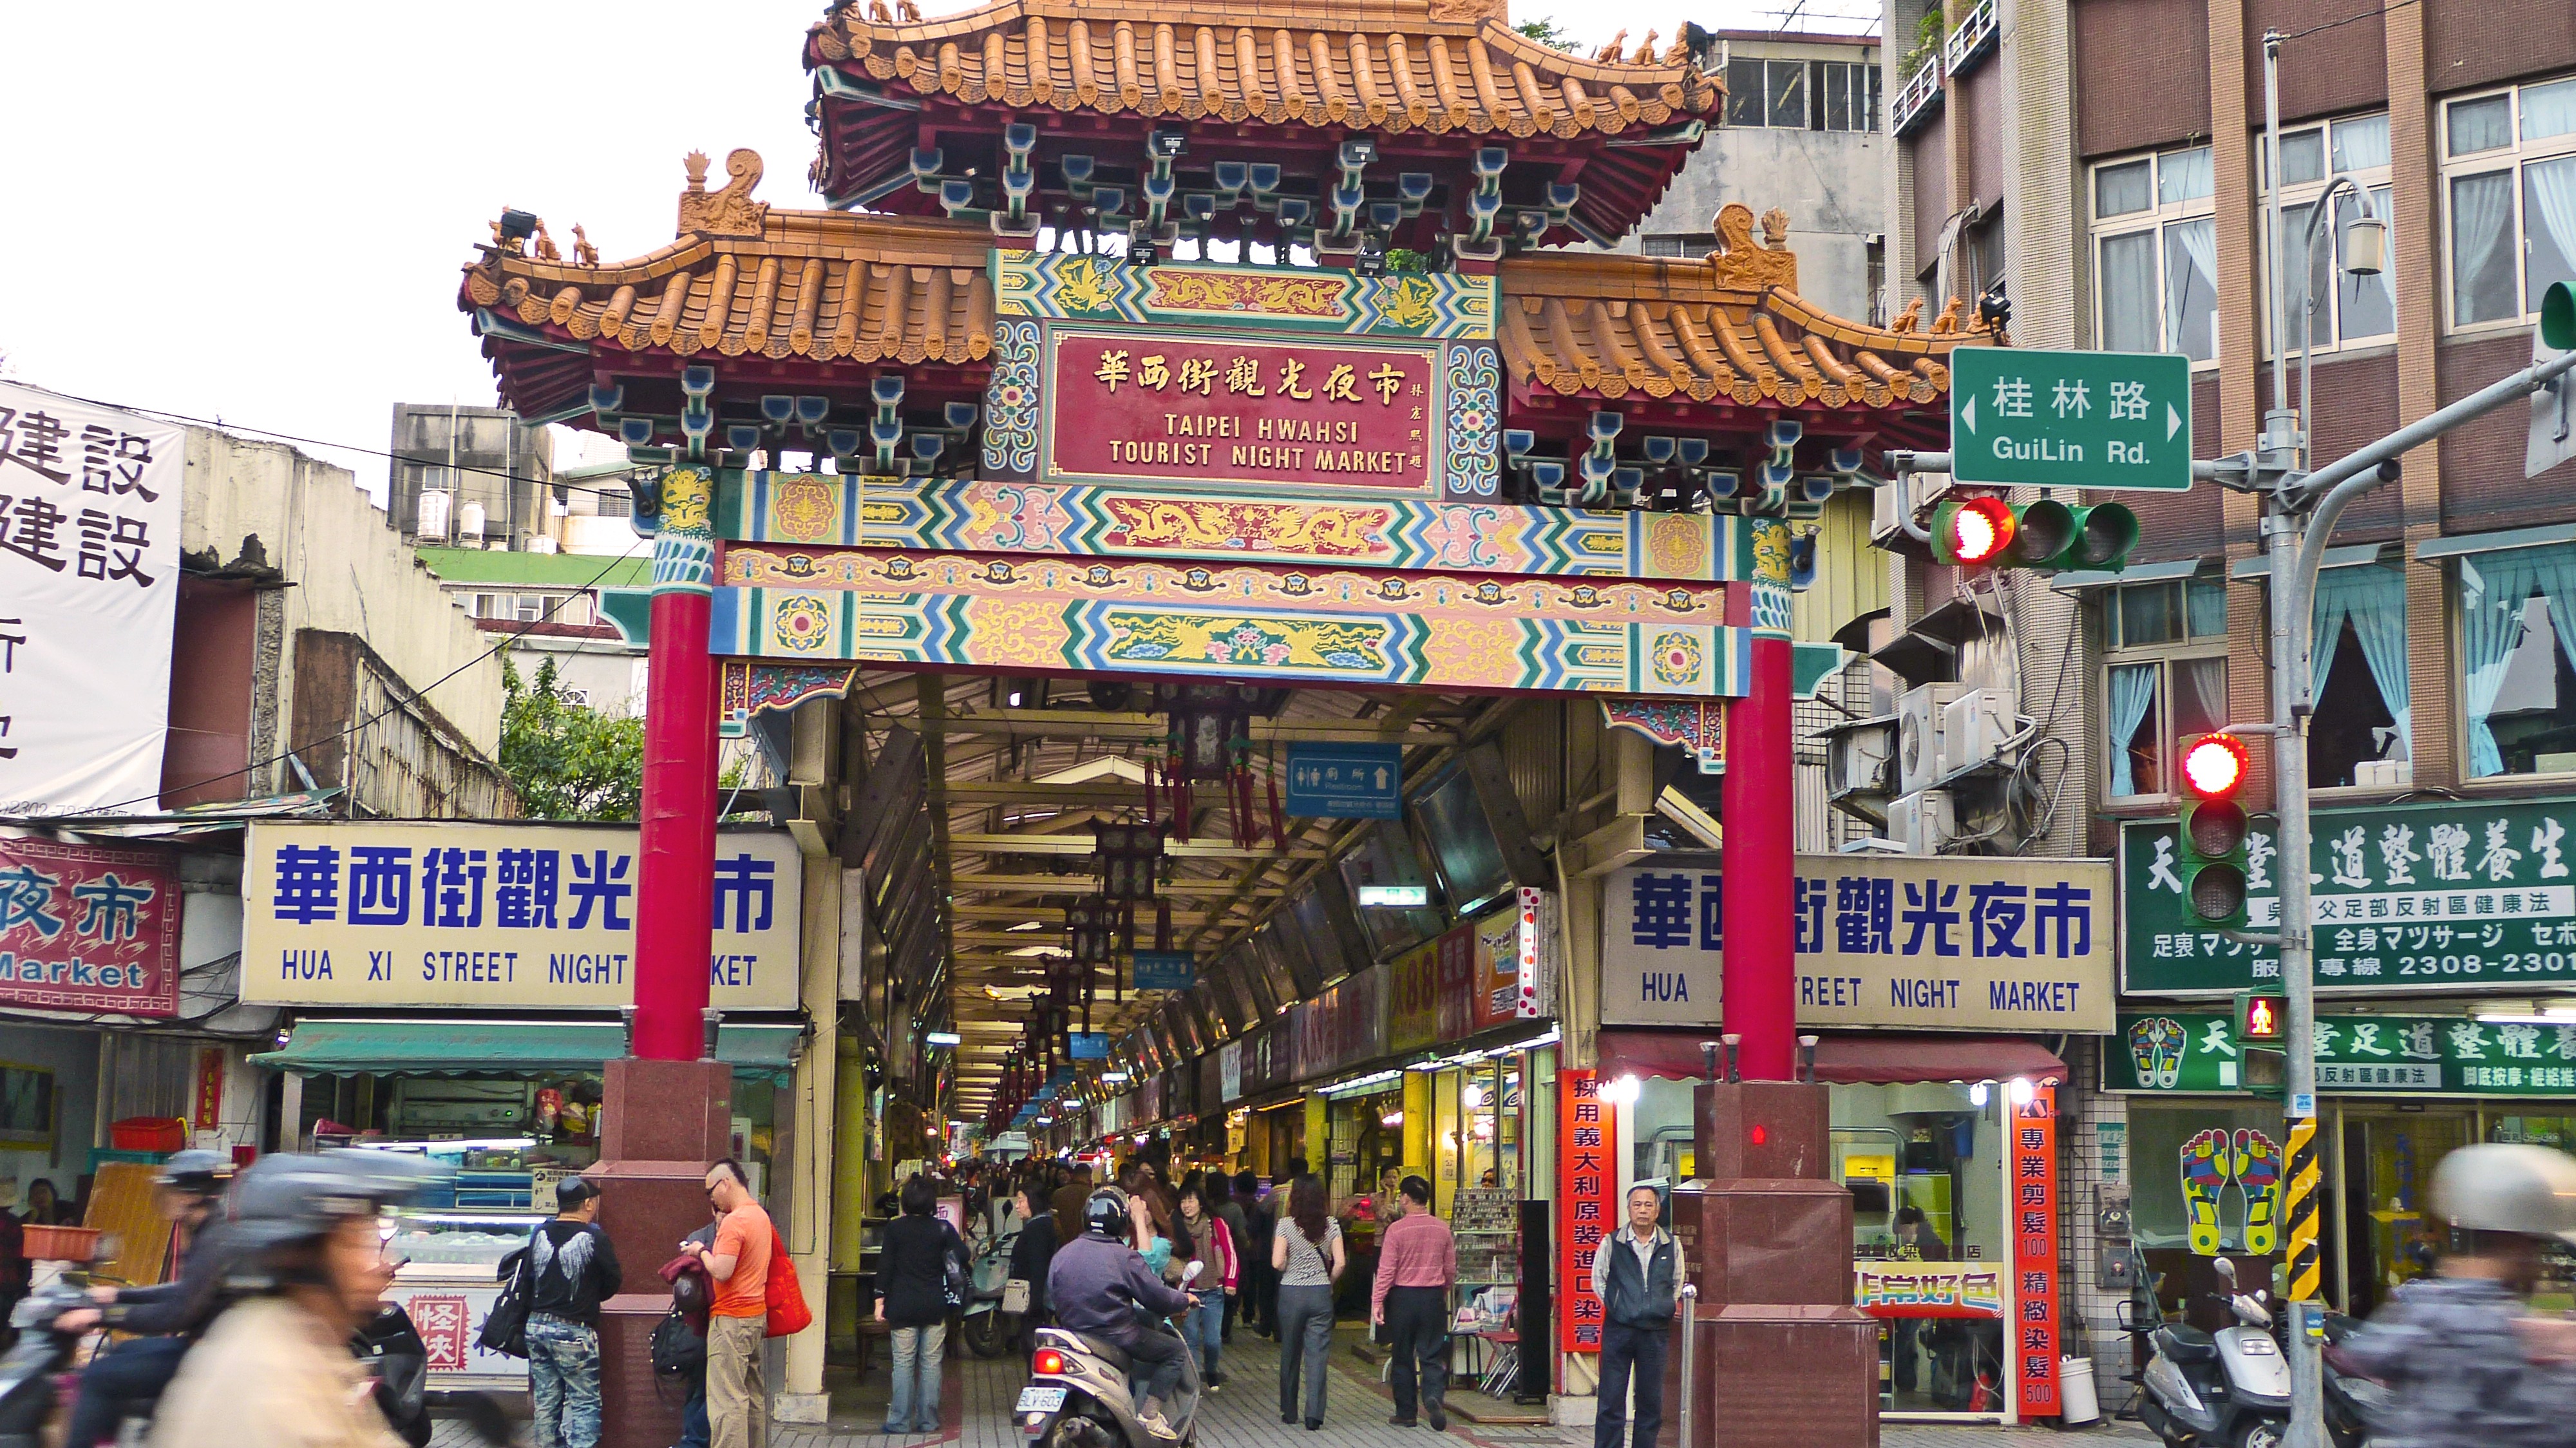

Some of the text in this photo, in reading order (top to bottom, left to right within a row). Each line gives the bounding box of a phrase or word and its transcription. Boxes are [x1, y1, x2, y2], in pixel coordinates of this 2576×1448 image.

[1094, 349, 1406, 406] 華西街觀光夜市
[1992, 376, 2151, 421] 桂林路
[1164, 413, 1358, 444] TAIPEI HWAHSI
[1110, 440, 1406, 475] TOURIST NIGHT MARKET
[1993, 436, 2150, 464] GuiLin Rd.
[2148, 817, 2569, 893] 天堂道整體養生
[0, 864, 156, 944] 夜市
[274, 844, 775, 933] 華西街觀光市
[2268, 892, 2550, 921] 吳父足部反射區健康法
[281, 950, 757, 986] HUA XI STREET NIGHT KET
[2252, 957, 2382, 978] 服專線
[1642, 972, 1689, 1002] HUA
[1795, 976, 1862, 1007] REET
[1891, 979, 1960, 1009] NIGHT
[1989, 980, 2079, 1012] MARKET
[2200, 1020, 2576, 1060] 天堂足道整體養
